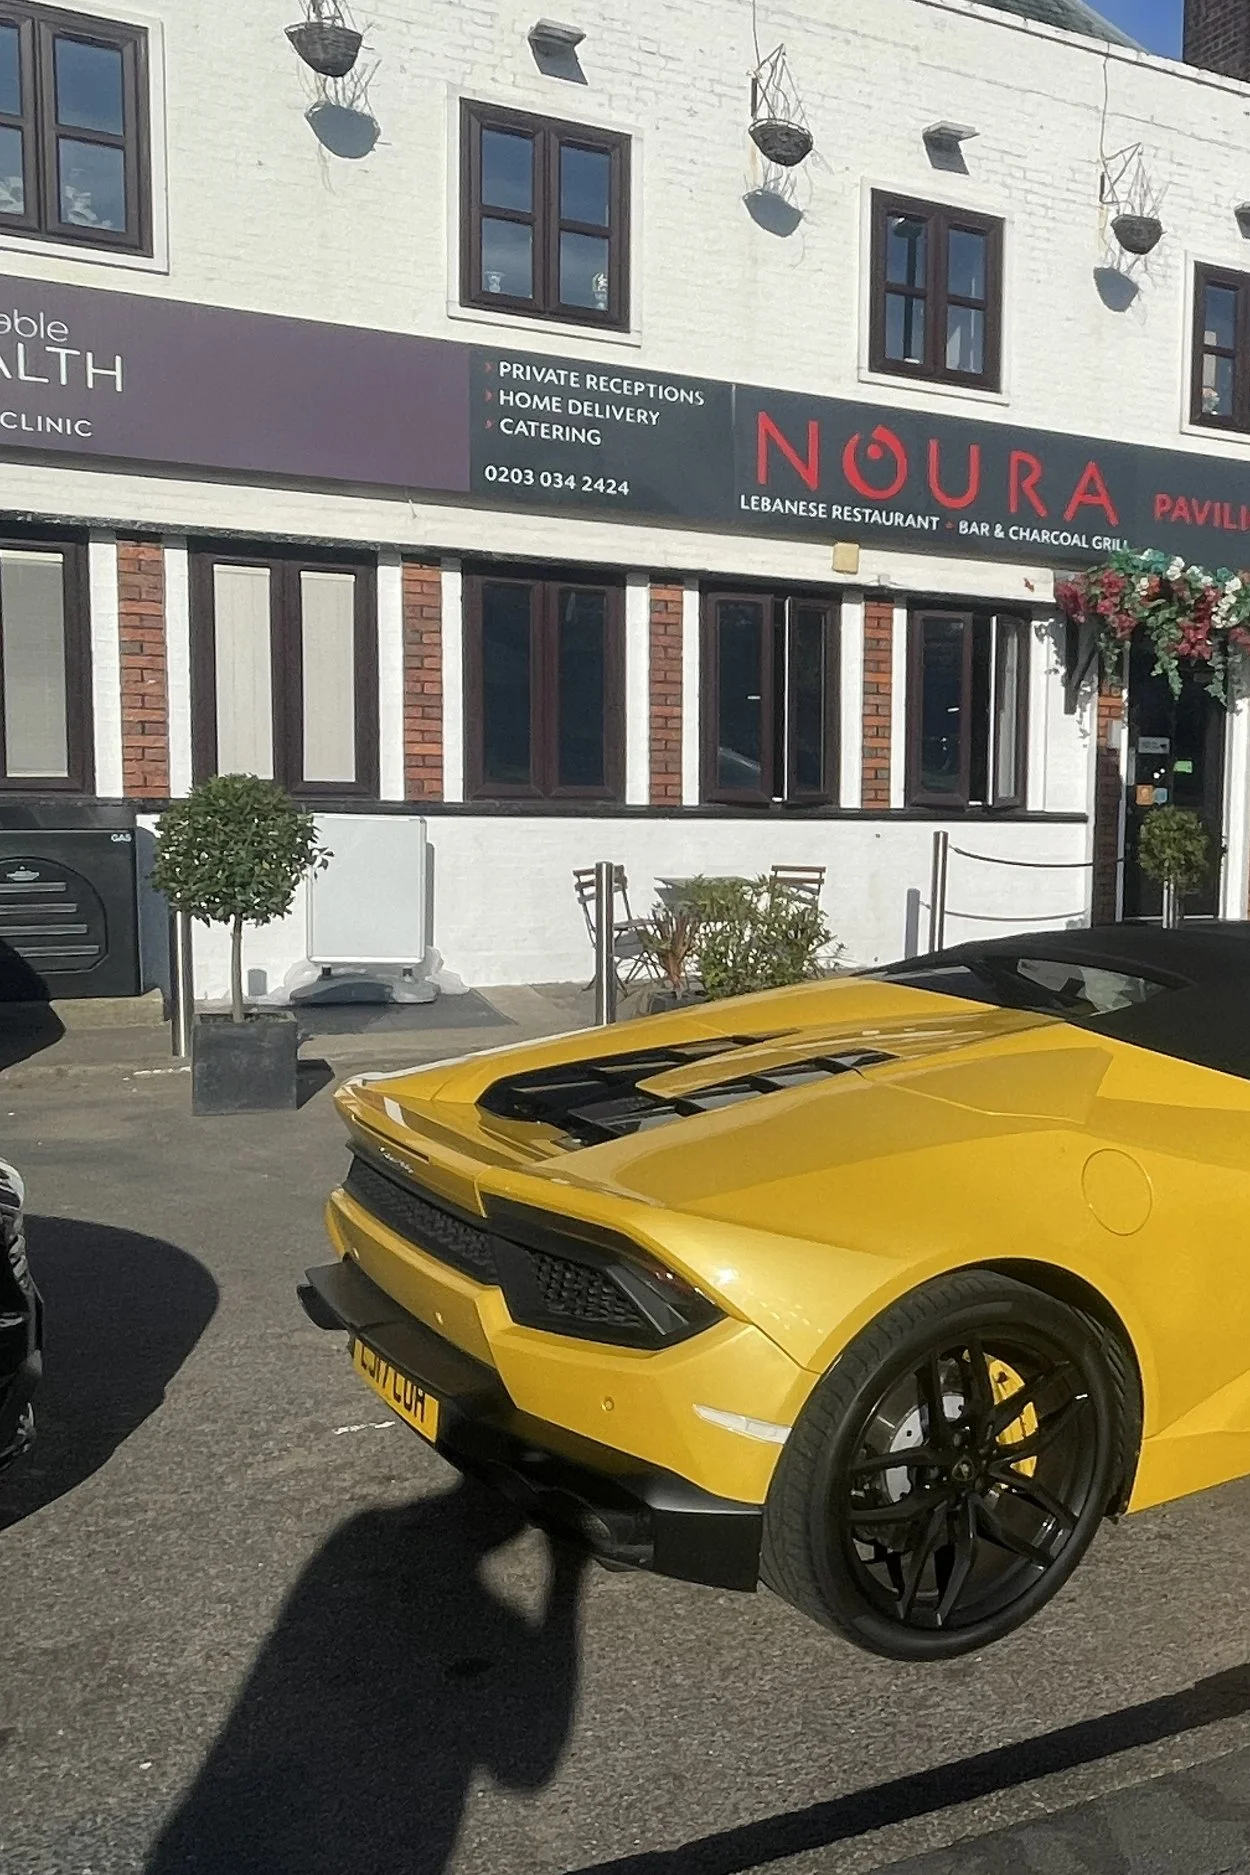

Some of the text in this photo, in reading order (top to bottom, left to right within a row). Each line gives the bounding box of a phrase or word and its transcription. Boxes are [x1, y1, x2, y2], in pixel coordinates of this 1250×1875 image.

[499, 361, 705, 406] PRIVATE RECEPTIONS
[0, 411, 93, 437] CLINIC
[499, 389, 660, 426] HOME DELIVERY
[499, 418, 602, 445] CATERING
[484, 465, 630, 496] 0203 034 2424
[757, 410, 1120, 527] NOURA
[740, 494, 827, 518] LEBANESE
[831, 504, 940, 531] RESTAURANT
[958, 519, 991, 537] BAR
[994, 523, 1005, 538] &
[1009, 526, 1089, 548] CHARCOAL
